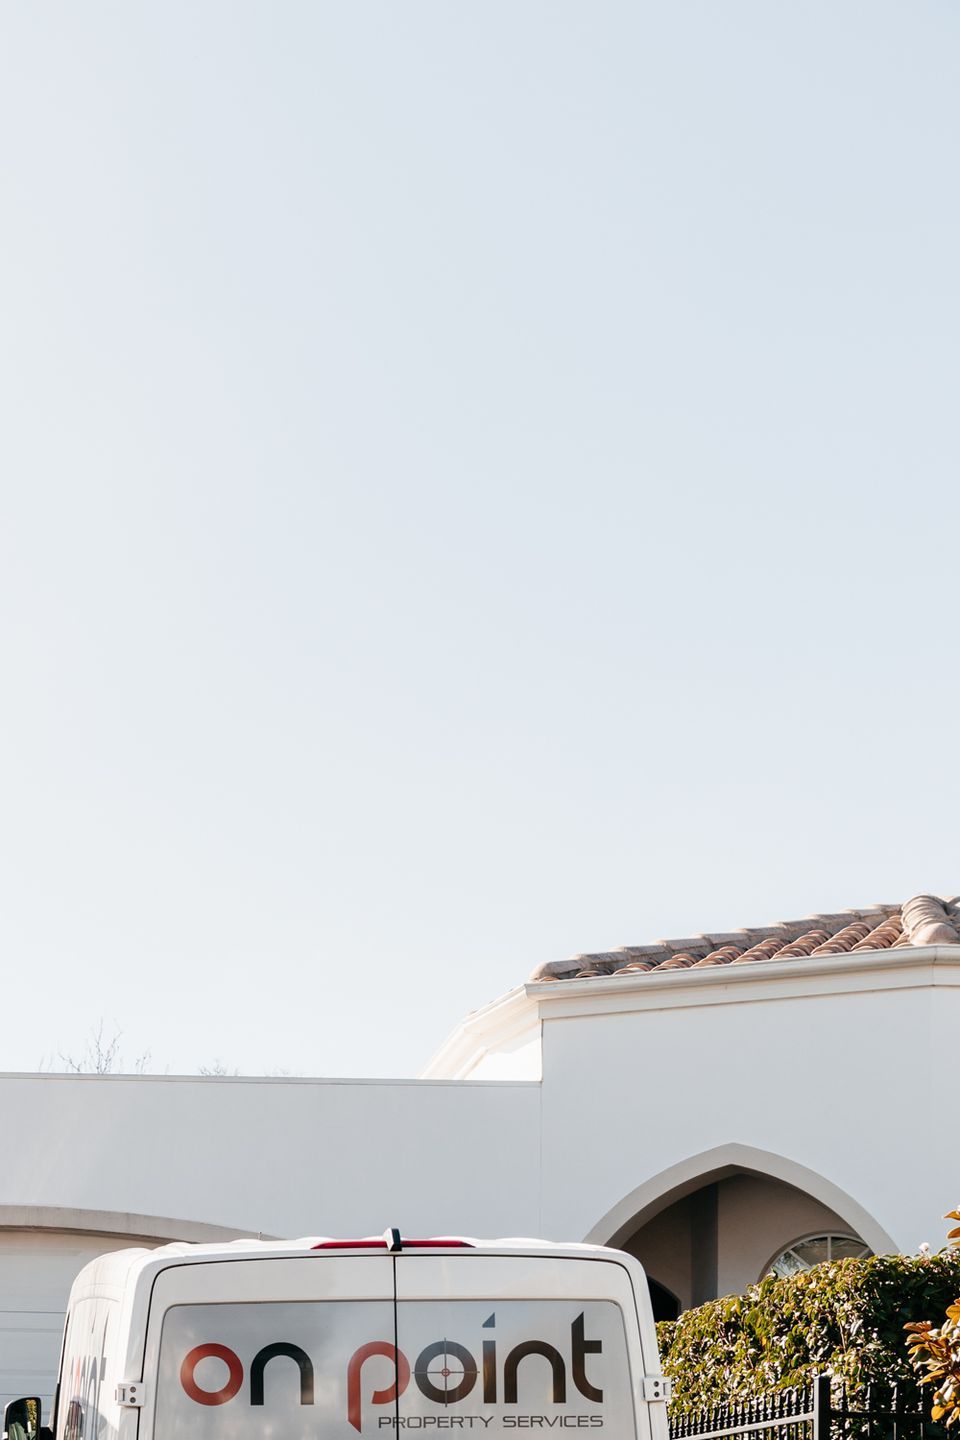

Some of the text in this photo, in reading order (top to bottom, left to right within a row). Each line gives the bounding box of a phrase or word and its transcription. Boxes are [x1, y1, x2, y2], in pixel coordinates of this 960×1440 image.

[180, 1341, 314, 1406] on
[347, 1311, 604, 1434] point
[378, 1415, 604, 1429] PROPERTY SERVICES
